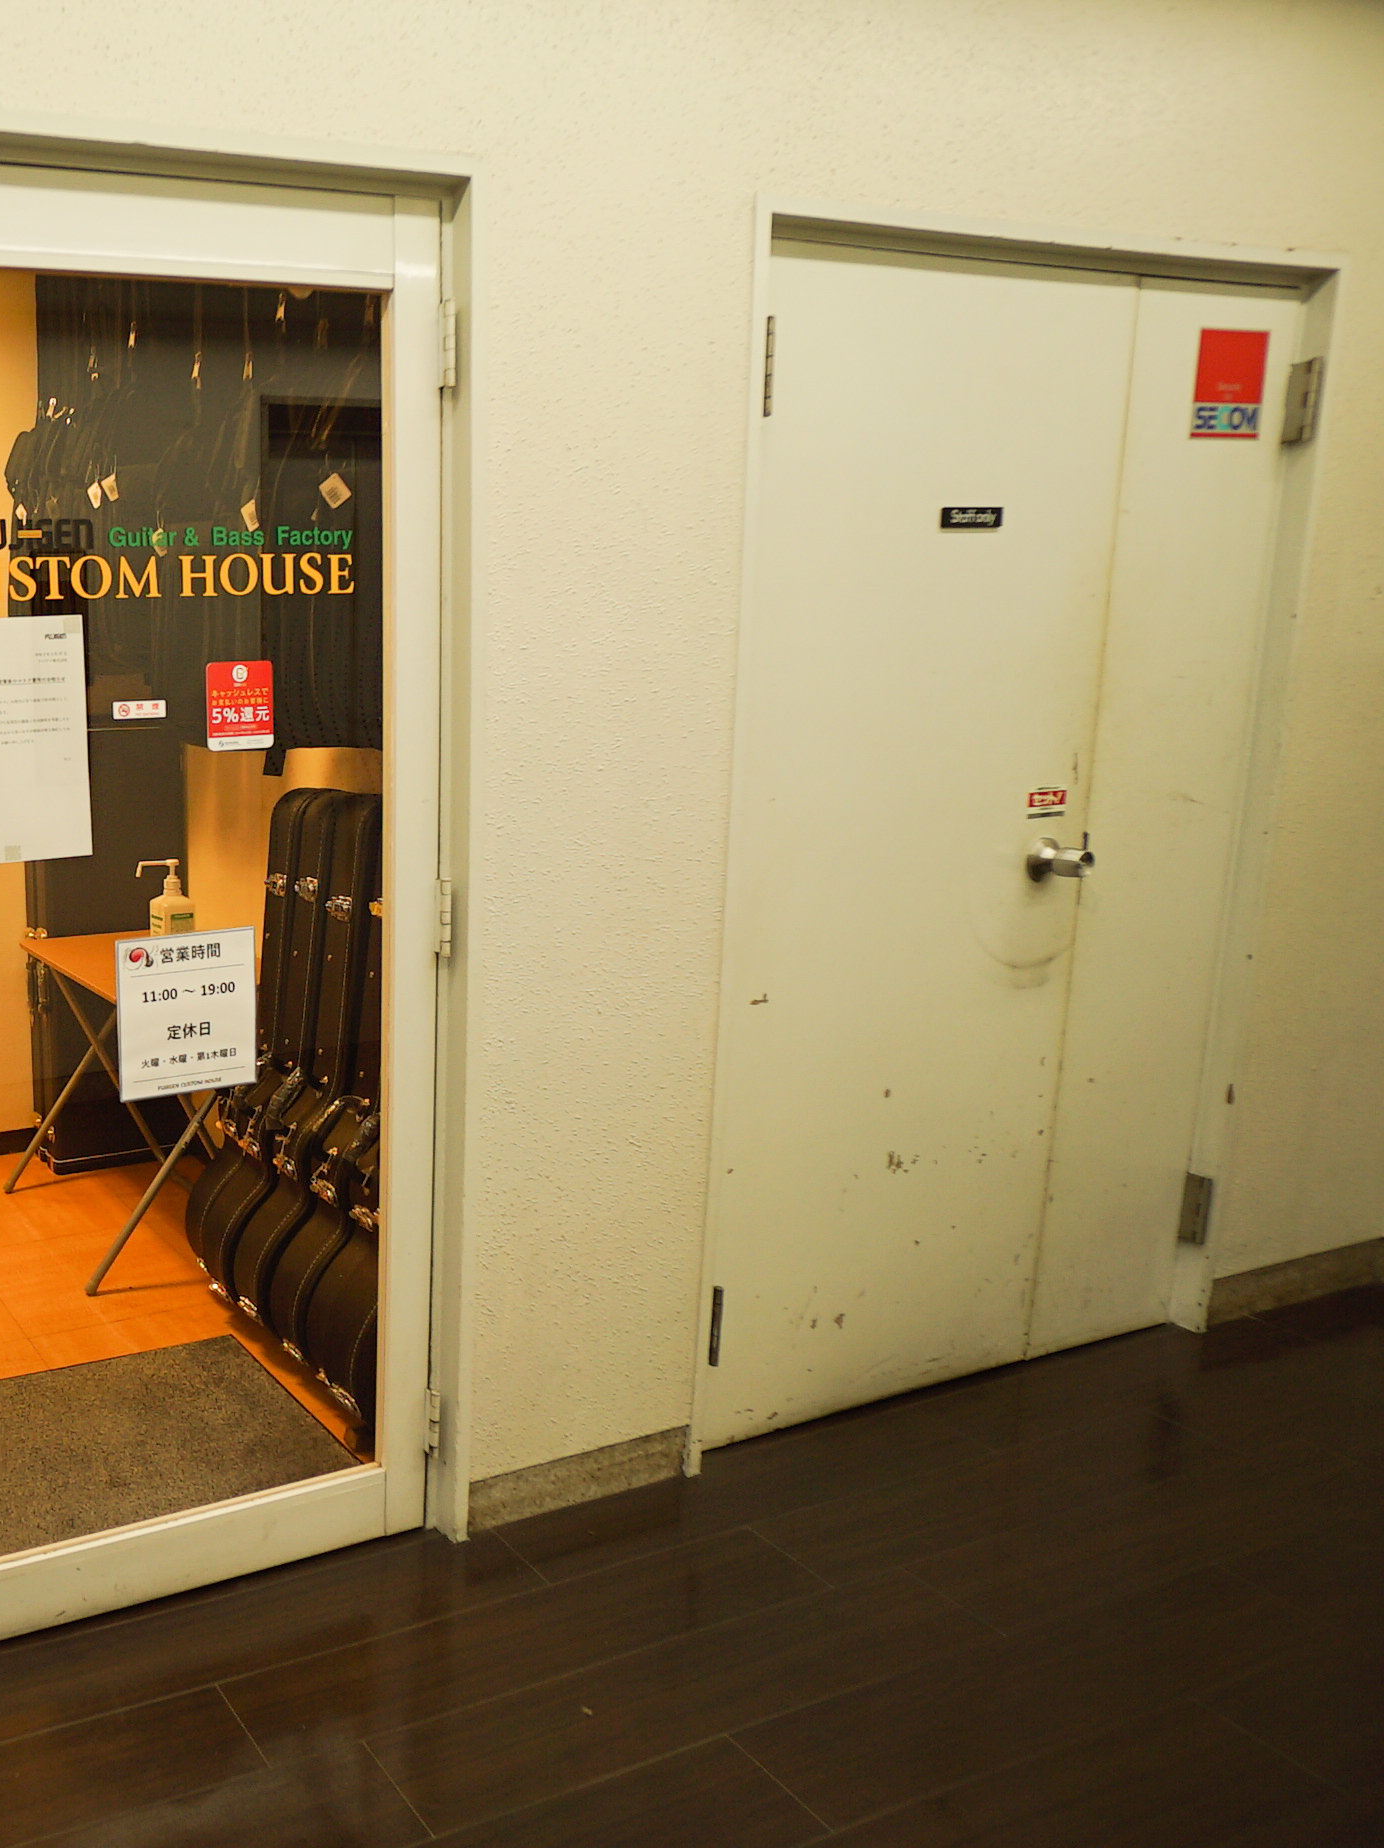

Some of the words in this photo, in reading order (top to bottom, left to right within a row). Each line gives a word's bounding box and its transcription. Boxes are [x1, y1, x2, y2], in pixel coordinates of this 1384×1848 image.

[1194, 405, 1258, 431] SECOM
[108, 526, 178, 547] Guitar
[184, 526, 200, 547] &
[212, 526, 264, 546] Bass
[277, 525, 354, 550] Factory
[178, 551, 356, 598] HOUSE
[211, 706, 270, 724] 5%還元
[160, 942, 221, 964] 営業時間
[142, 988, 178, 1003] 11:00
[201, 981, 236, 996] 19:00
[167, 1021, 211, 1040] 定休日
